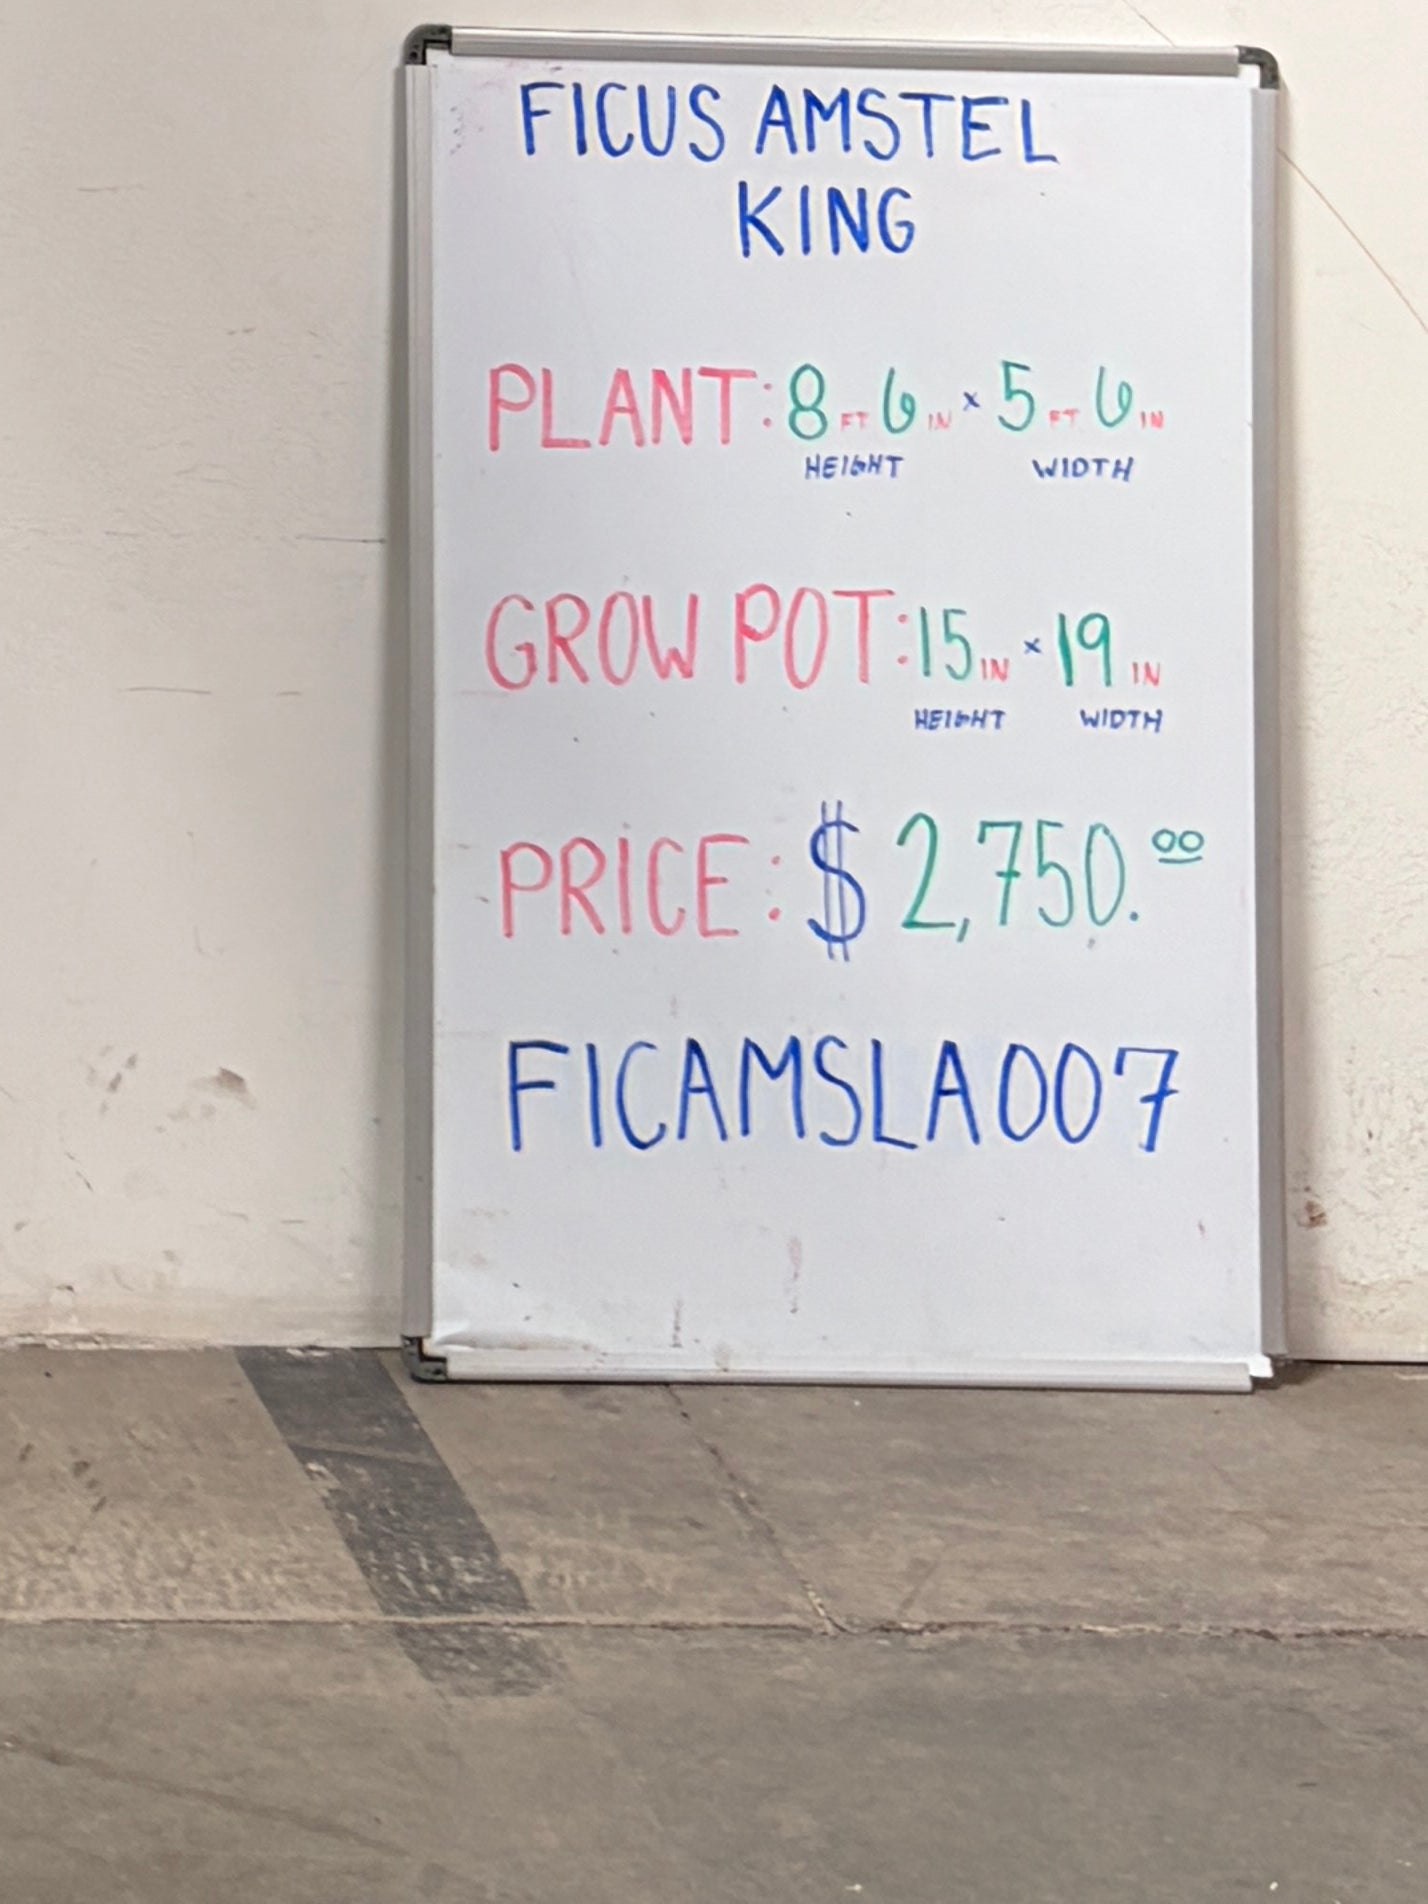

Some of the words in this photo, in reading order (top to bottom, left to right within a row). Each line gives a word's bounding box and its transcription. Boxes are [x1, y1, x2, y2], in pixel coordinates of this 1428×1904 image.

[518, 80, 727, 163] FICUS
[753, 84, 1060, 165] AMSTEL
[736, 179, 917, 258] KING
[487, 362, 774, 453] PLANT:
[787, 363, 829, 441] 8
[841, 411, 869, 430] FT
[882, 366, 917, 434] 6
[997, 359, 1036, 433] 5
[1048, 408, 1080, 425] FT
[1095, 365, 1134, 429] 6
[1140, 410, 1166, 430] IN
[804, 453, 905, 481] HEIGHT
[1032, 456, 1135, 483] WIDTH
[485, 592, 701, 691] GROW
[733, 583, 909, 690] POT:
[919, 605, 973, 682] 15
[1056, 611, 1113, 688] 19
[1132, 661, 1162, 687] IN
[913, 708, 1007, 732] HEIGHT
[1079, 708, 1164, 734] WIDTH
[500, 832, 782, 940] PRICE:
[507, 1034, 1180, 1153] FICAMSLA007
